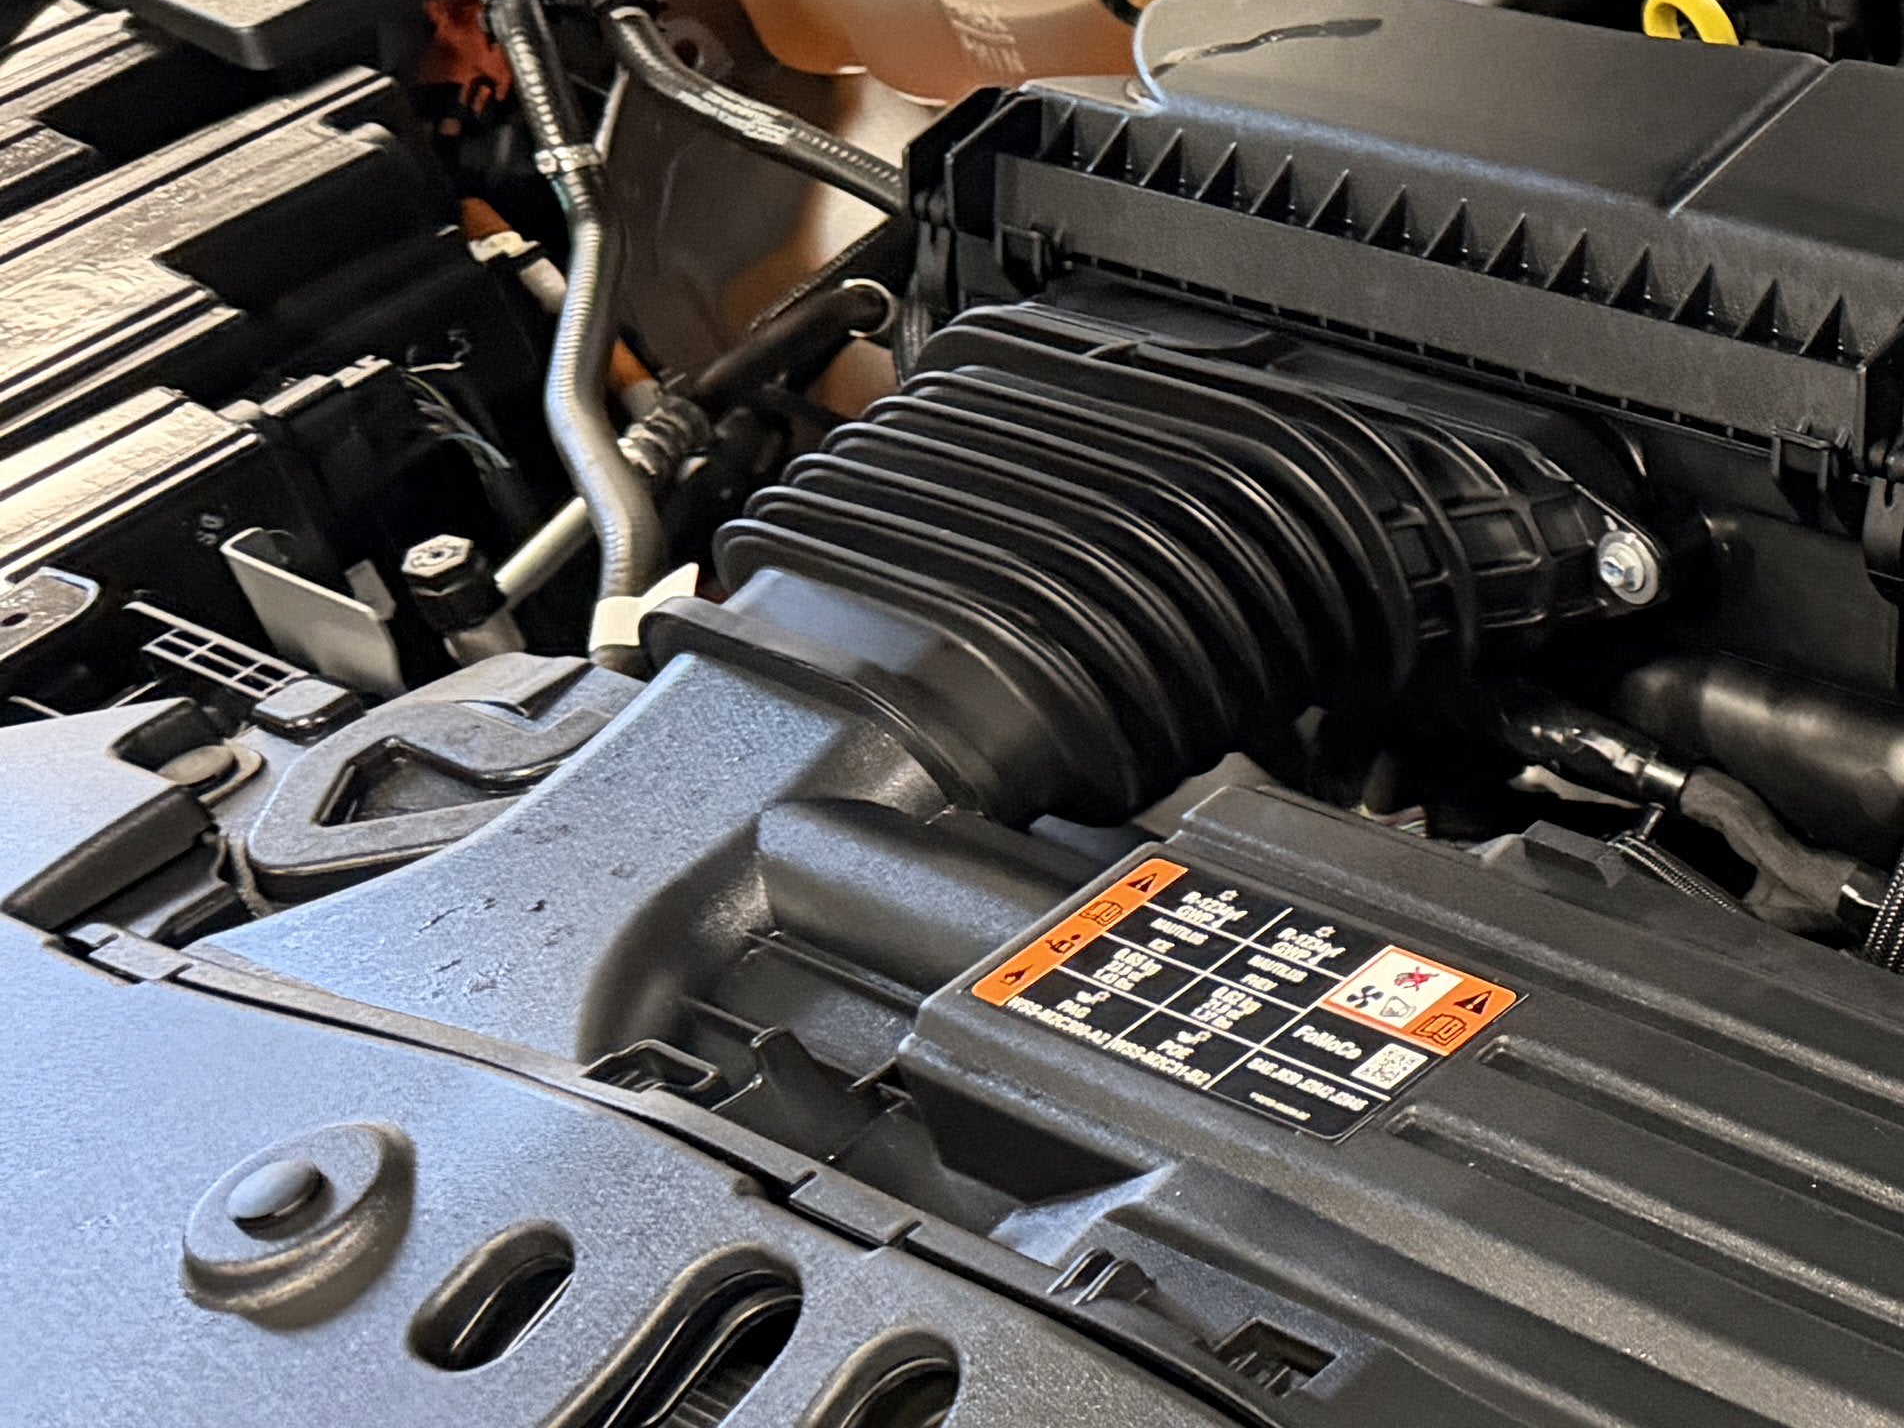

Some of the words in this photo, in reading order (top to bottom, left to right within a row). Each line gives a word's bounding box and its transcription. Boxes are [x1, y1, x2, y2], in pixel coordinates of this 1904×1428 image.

[1172, 905, 1214, 925] GWP
[1150, 918, 1207, 944] NAUTILUS
[1268, 941, 1311, 961] GWP
[1248, 954, 1306, 981] NAUTILUS
[1056, 999, 1090, 1018] PAG
[1156, 1039, 1193, 1059] POE
[1293, 1025, 1361, 1058] FoMoCo
